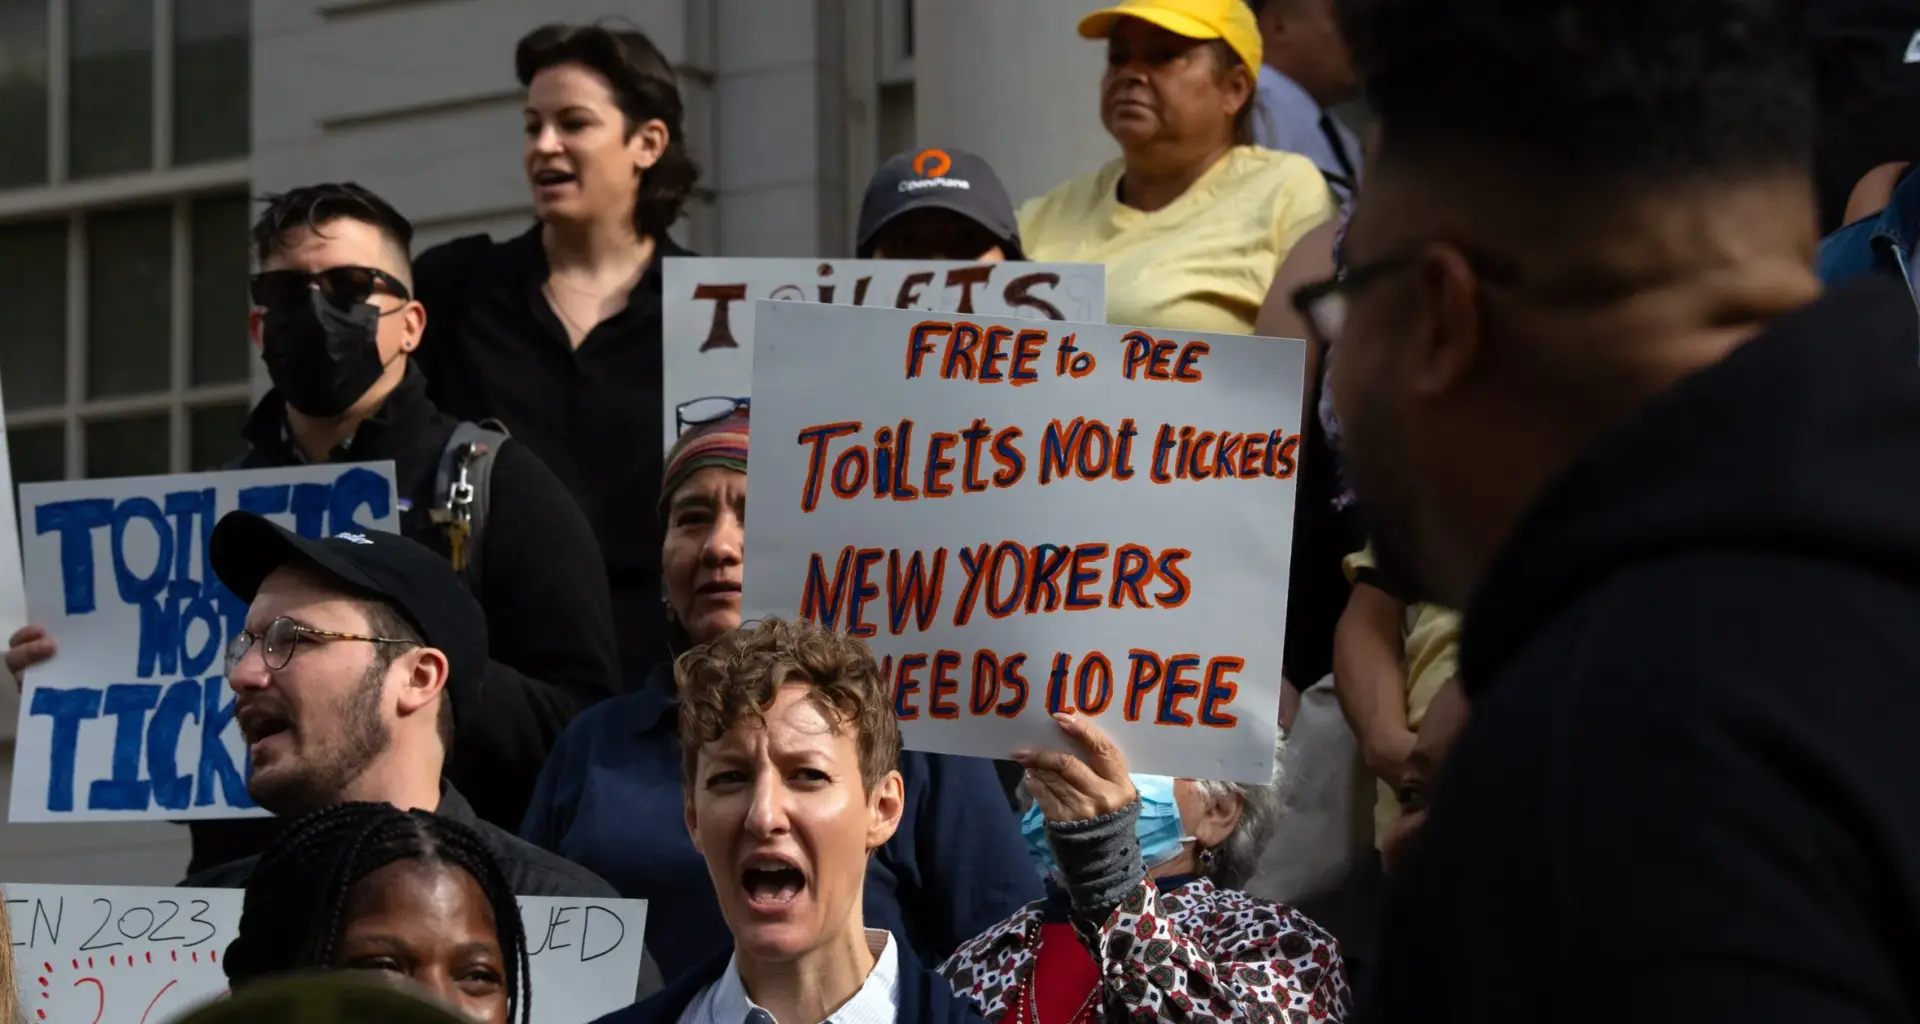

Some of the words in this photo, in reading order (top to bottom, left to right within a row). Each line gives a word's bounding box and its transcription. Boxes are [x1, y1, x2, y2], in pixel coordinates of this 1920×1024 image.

[905, 321, 1048, 386] FREE
[1056, 333, 1096, 379] to
[1120, 330, 1209, 383] PEE
[1123, 648, 1244, 728] PEE
[30, 679, 256, 812] TICK
[79, 898, 216, 951] 2023
[520, 905, 625, 962] UED
